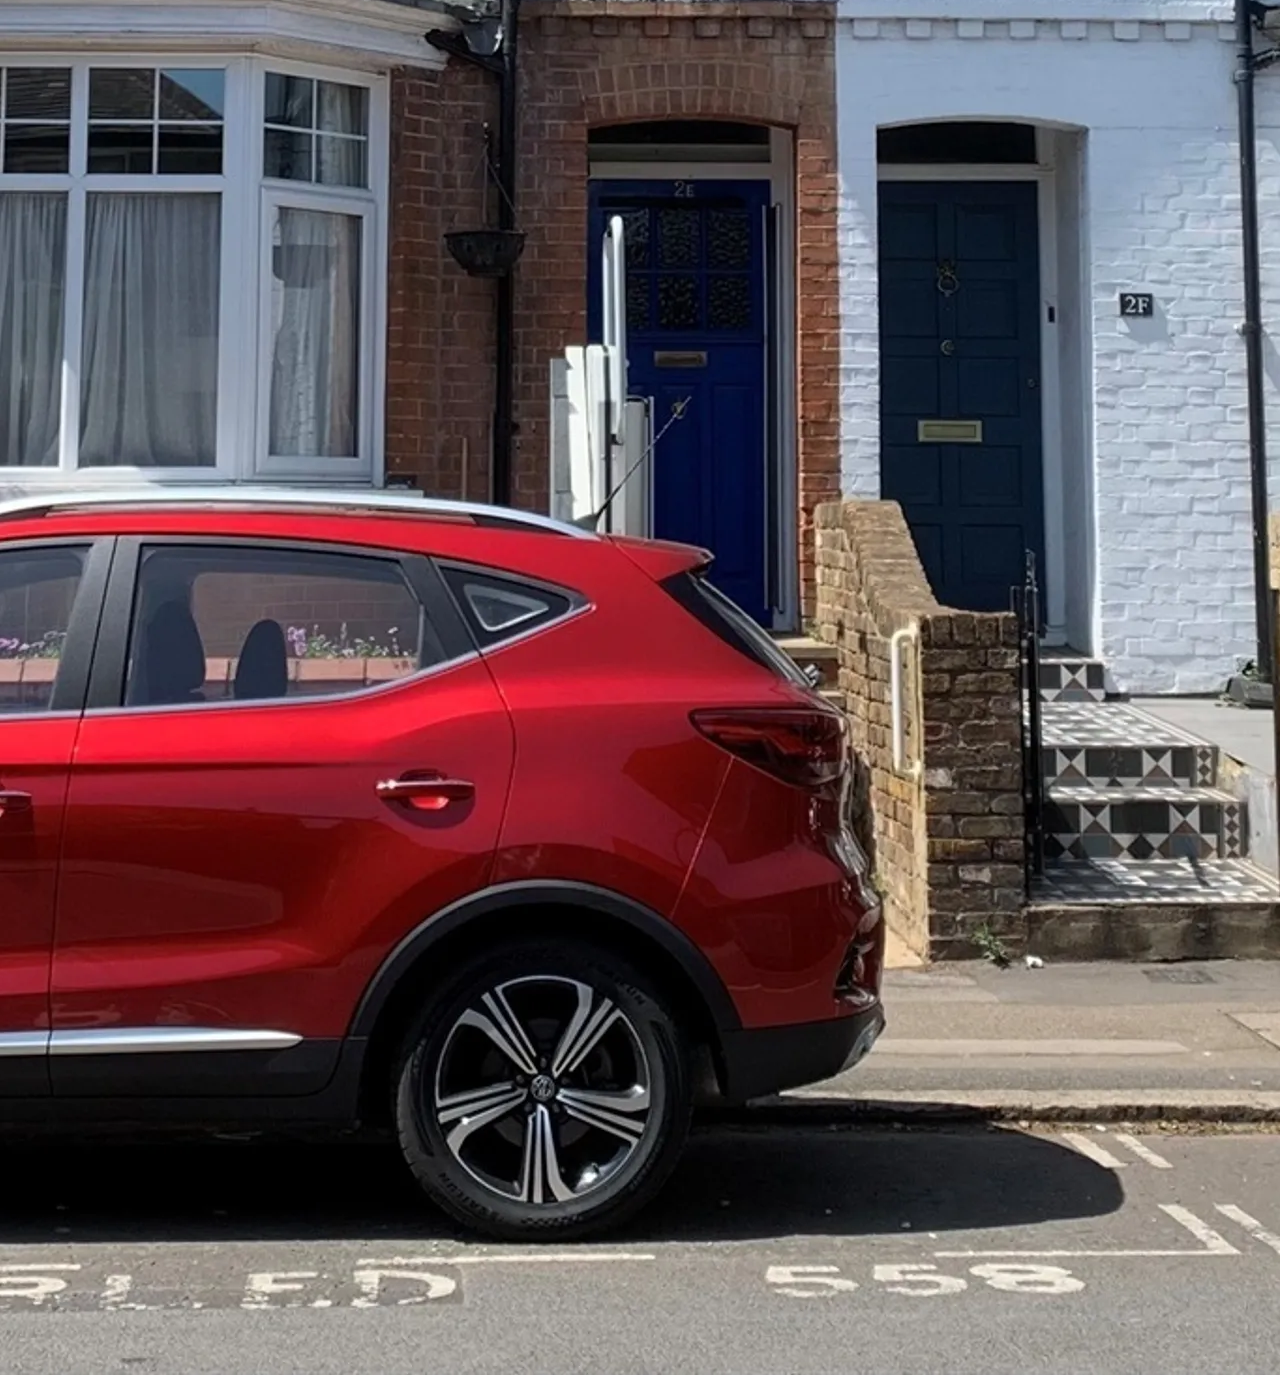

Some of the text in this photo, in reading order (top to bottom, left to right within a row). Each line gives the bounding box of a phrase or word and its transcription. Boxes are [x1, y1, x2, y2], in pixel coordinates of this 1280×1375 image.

[673, 180, 696, 198] 2E
[1125, 295, 1150, 313] 2F
[764, 1263, 1086, 1298] 558
